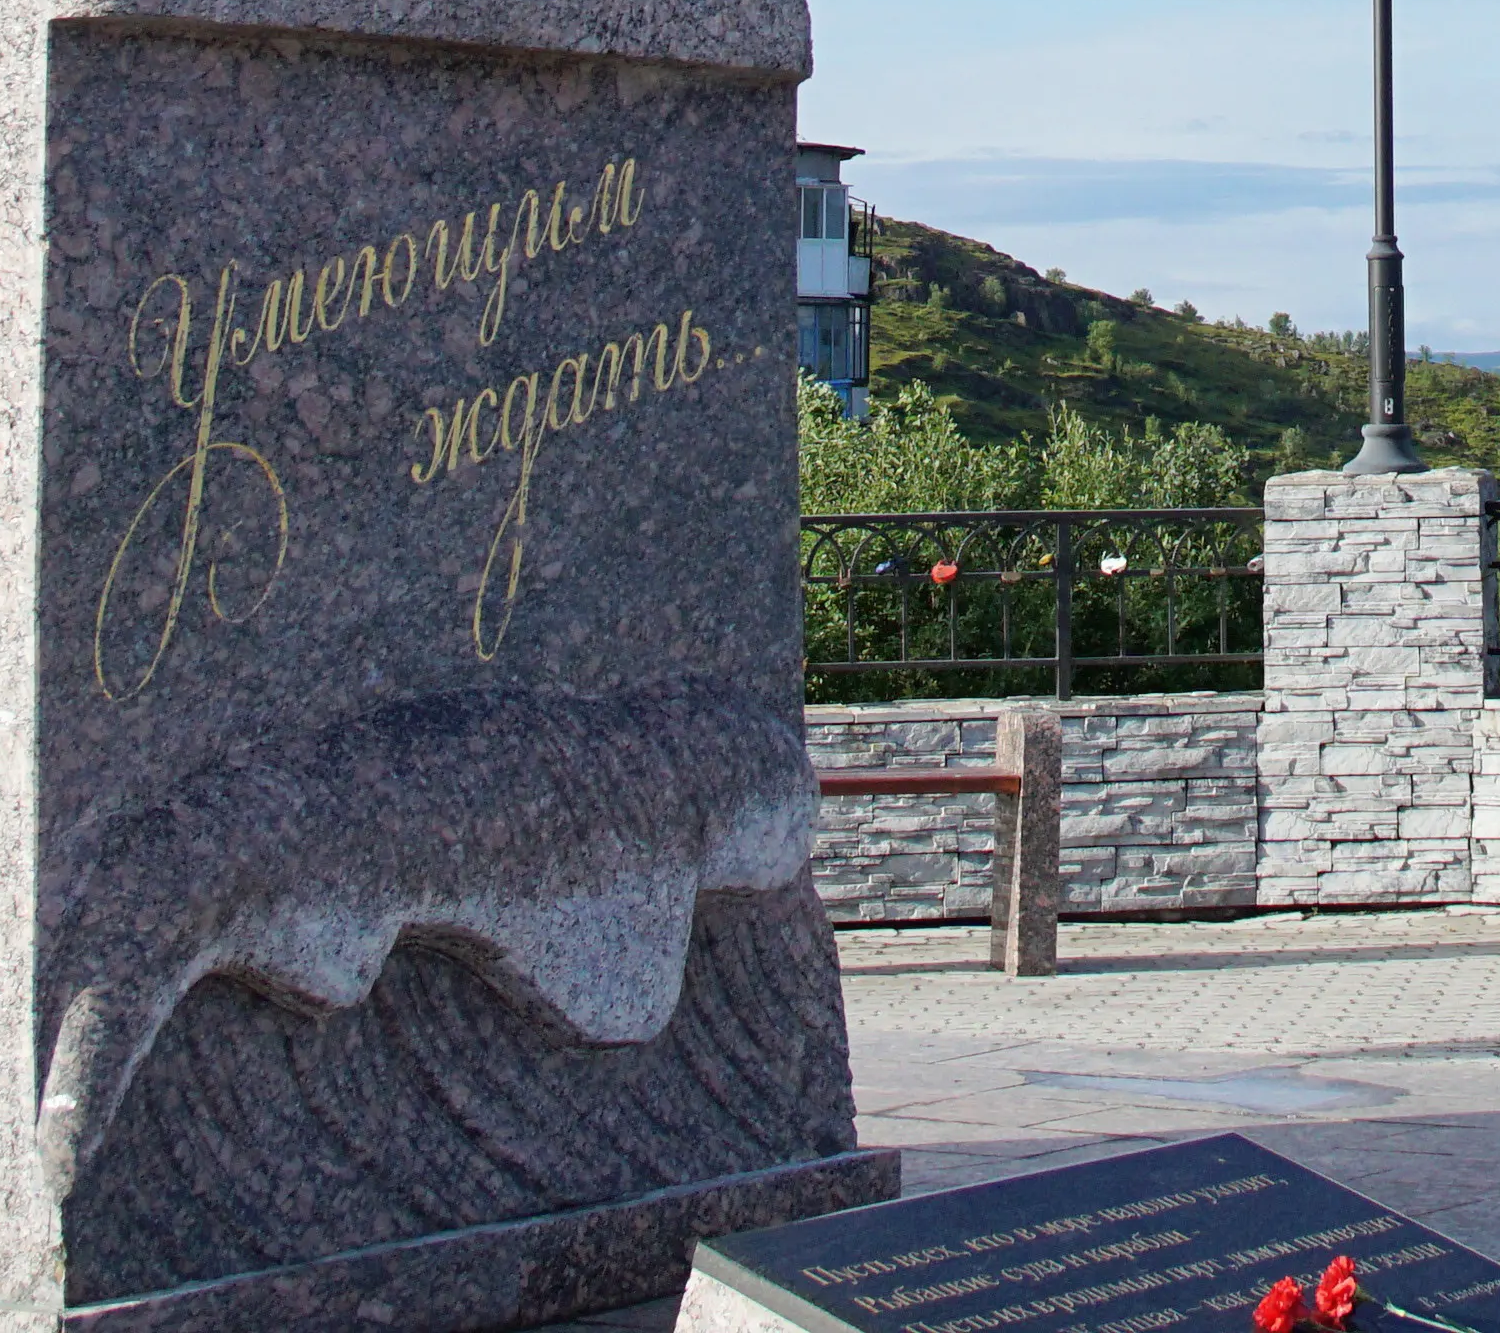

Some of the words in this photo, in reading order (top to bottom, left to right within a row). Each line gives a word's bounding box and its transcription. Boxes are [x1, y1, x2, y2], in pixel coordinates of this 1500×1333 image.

[94, 156, 646, 703] Умеющим
[802, 1259, 897, 1286] Пусть
[894, 1244, 972, 1269] всех,
[964, 1232, 1015, 1253] кто
[1013, 1227, 1037, 1242] в
[1035, 1214, 1101, 1234] море
[853, 1273, 1000, 1314] Рыбацкие
[1000, 1258, 1067, 1282] суда
[1061, 1252, 1088, 1269] и
[1084, 1228, 1192, 1261] корабли
[905, 1312, 1000, 1333] Пусть
[993, 1303, 1039, 1323] их
[1030, 1300, 1056, 1315] в
[1201, 1290, 1255, 1311] как
